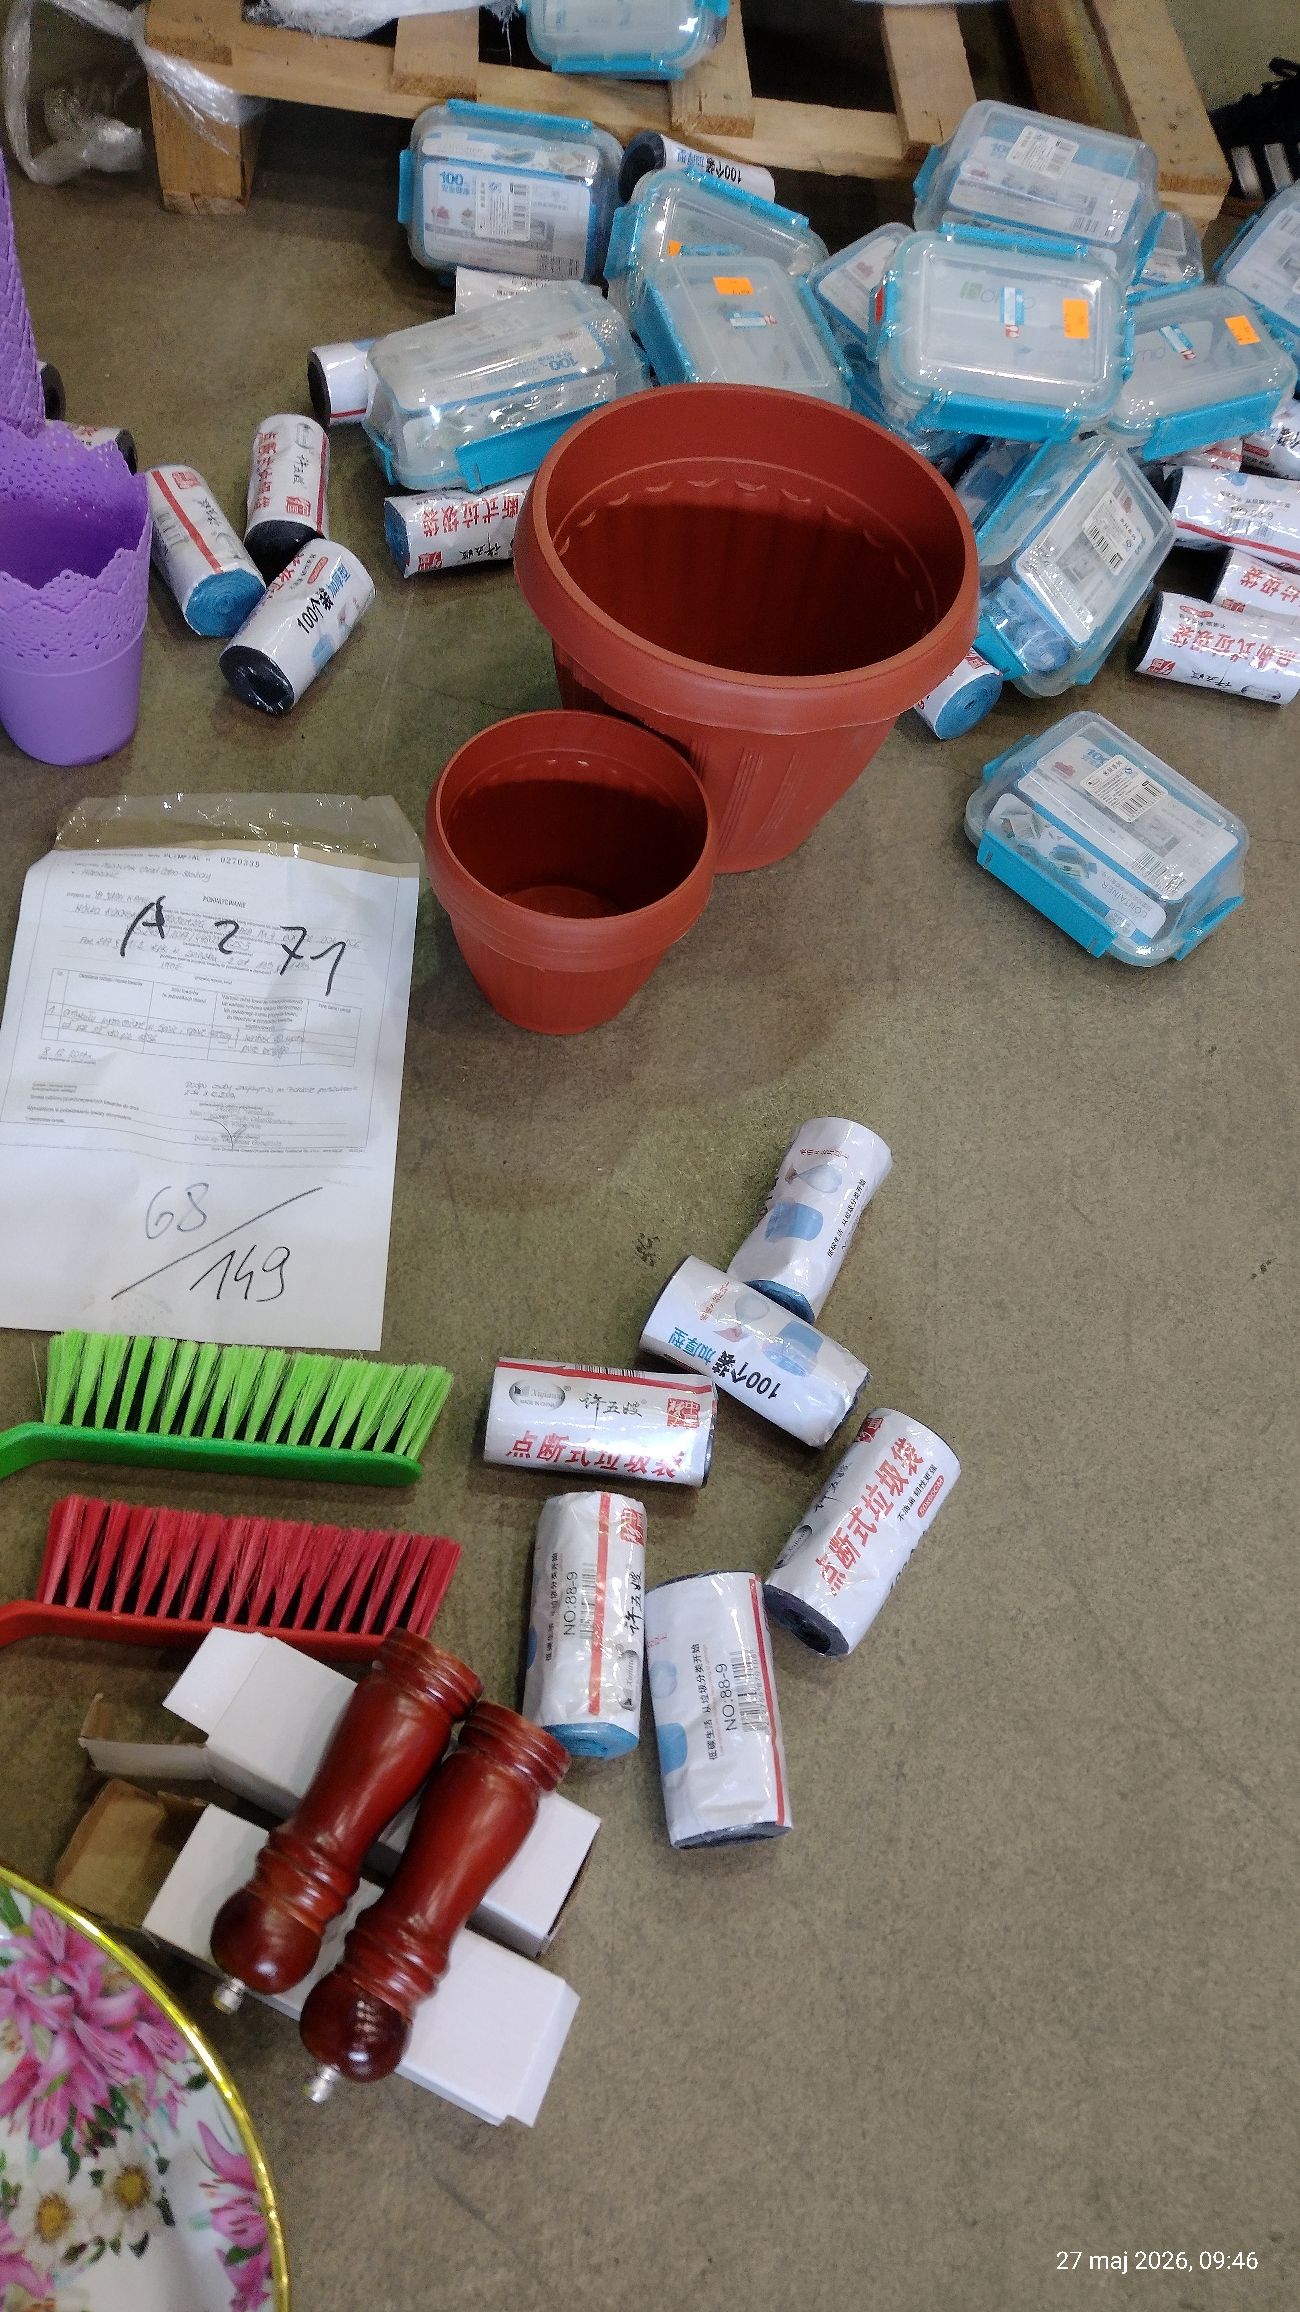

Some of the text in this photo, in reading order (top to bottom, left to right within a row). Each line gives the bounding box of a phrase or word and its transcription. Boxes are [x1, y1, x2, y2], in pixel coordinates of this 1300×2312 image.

[119, 895, 166, 957] A
[145, 1182, 209, 1239] 68
[189, 1244, 290, 1302] 149
[815, 1437, 925, 1597] 点断式垃圾袋
[690, 1643, 712, 1714] 从垃圾分类开始
[714, 1663, 737, 1732] NO:88-9
